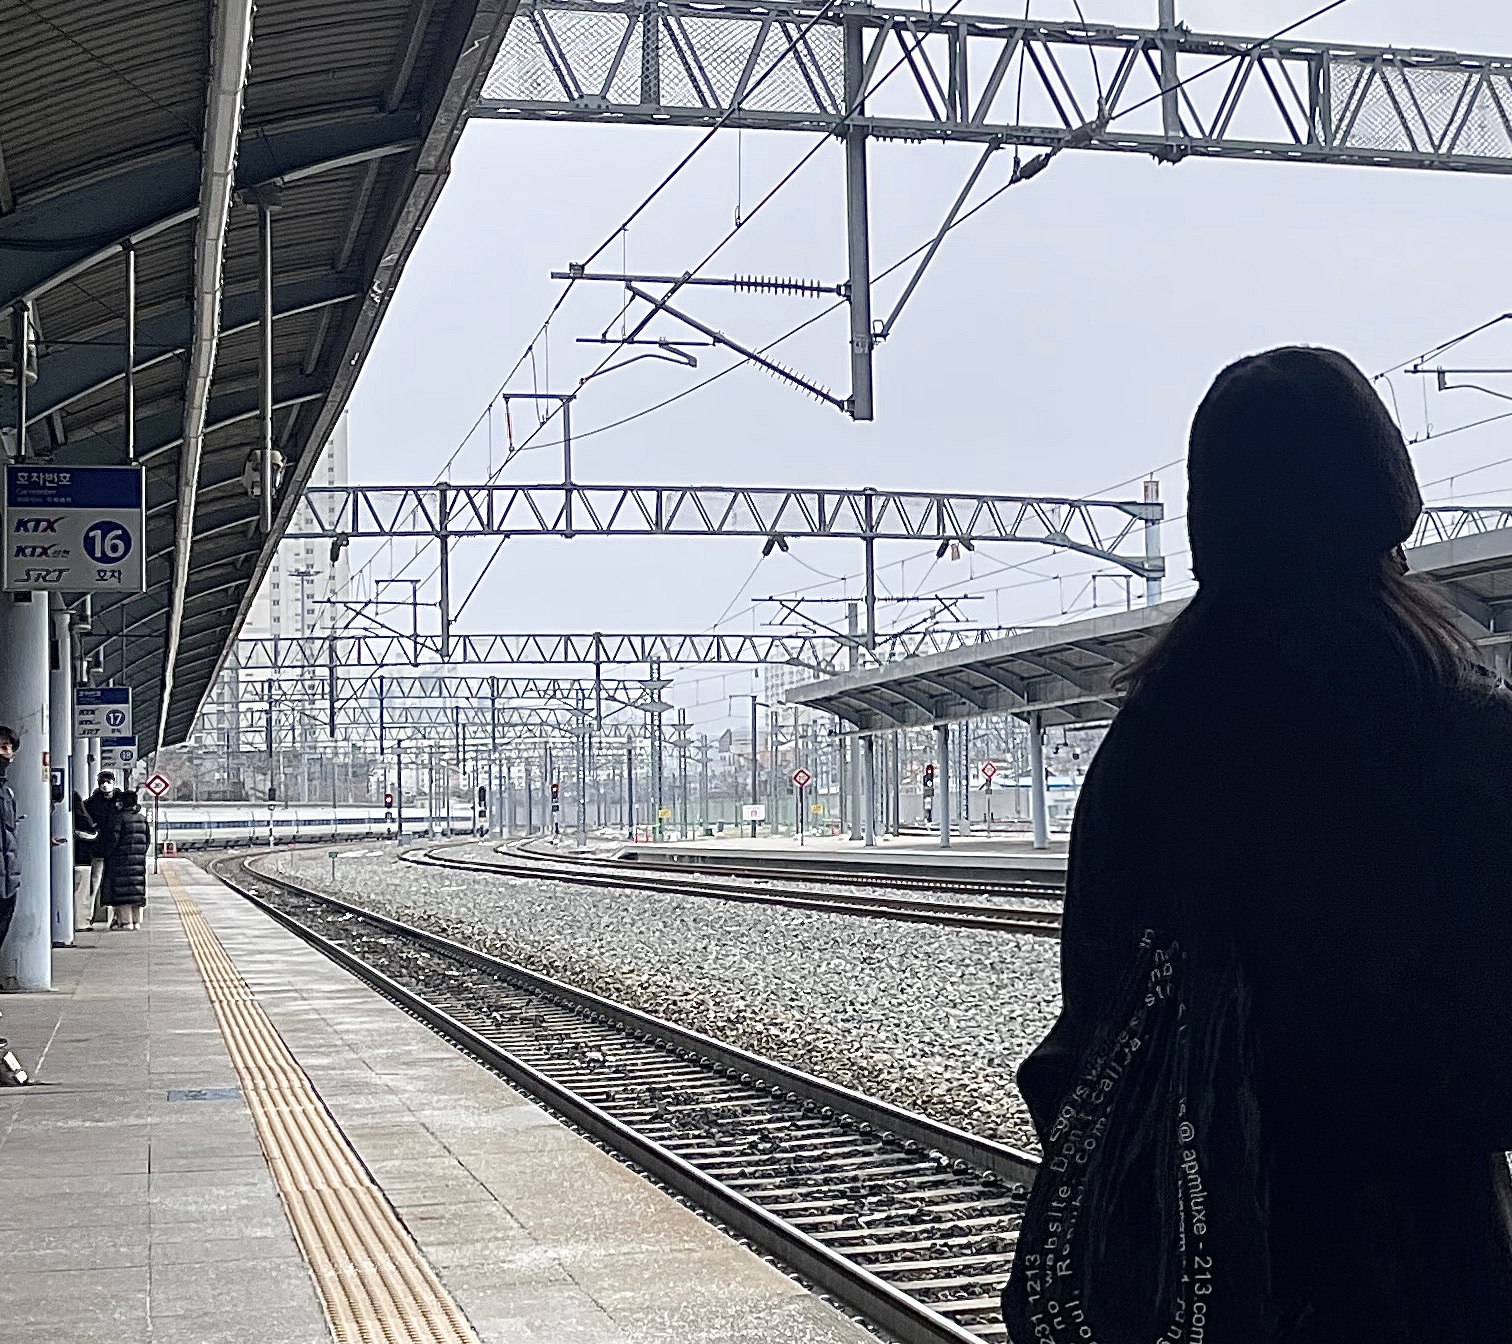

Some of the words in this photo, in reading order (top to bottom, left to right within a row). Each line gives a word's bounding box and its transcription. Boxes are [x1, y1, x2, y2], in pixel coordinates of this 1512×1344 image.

[13, 516, 66, 533] KTX
[88, 529, 125, 558] 16
[13, 568, 71, 583] SRT
[108, 713, 122, 725] 17
[1181, 1149, 1208, 1236] apmluxe
[1025, 1254, 1041, 1304] 1213
[1047, 1300, 1066, 1330] no
